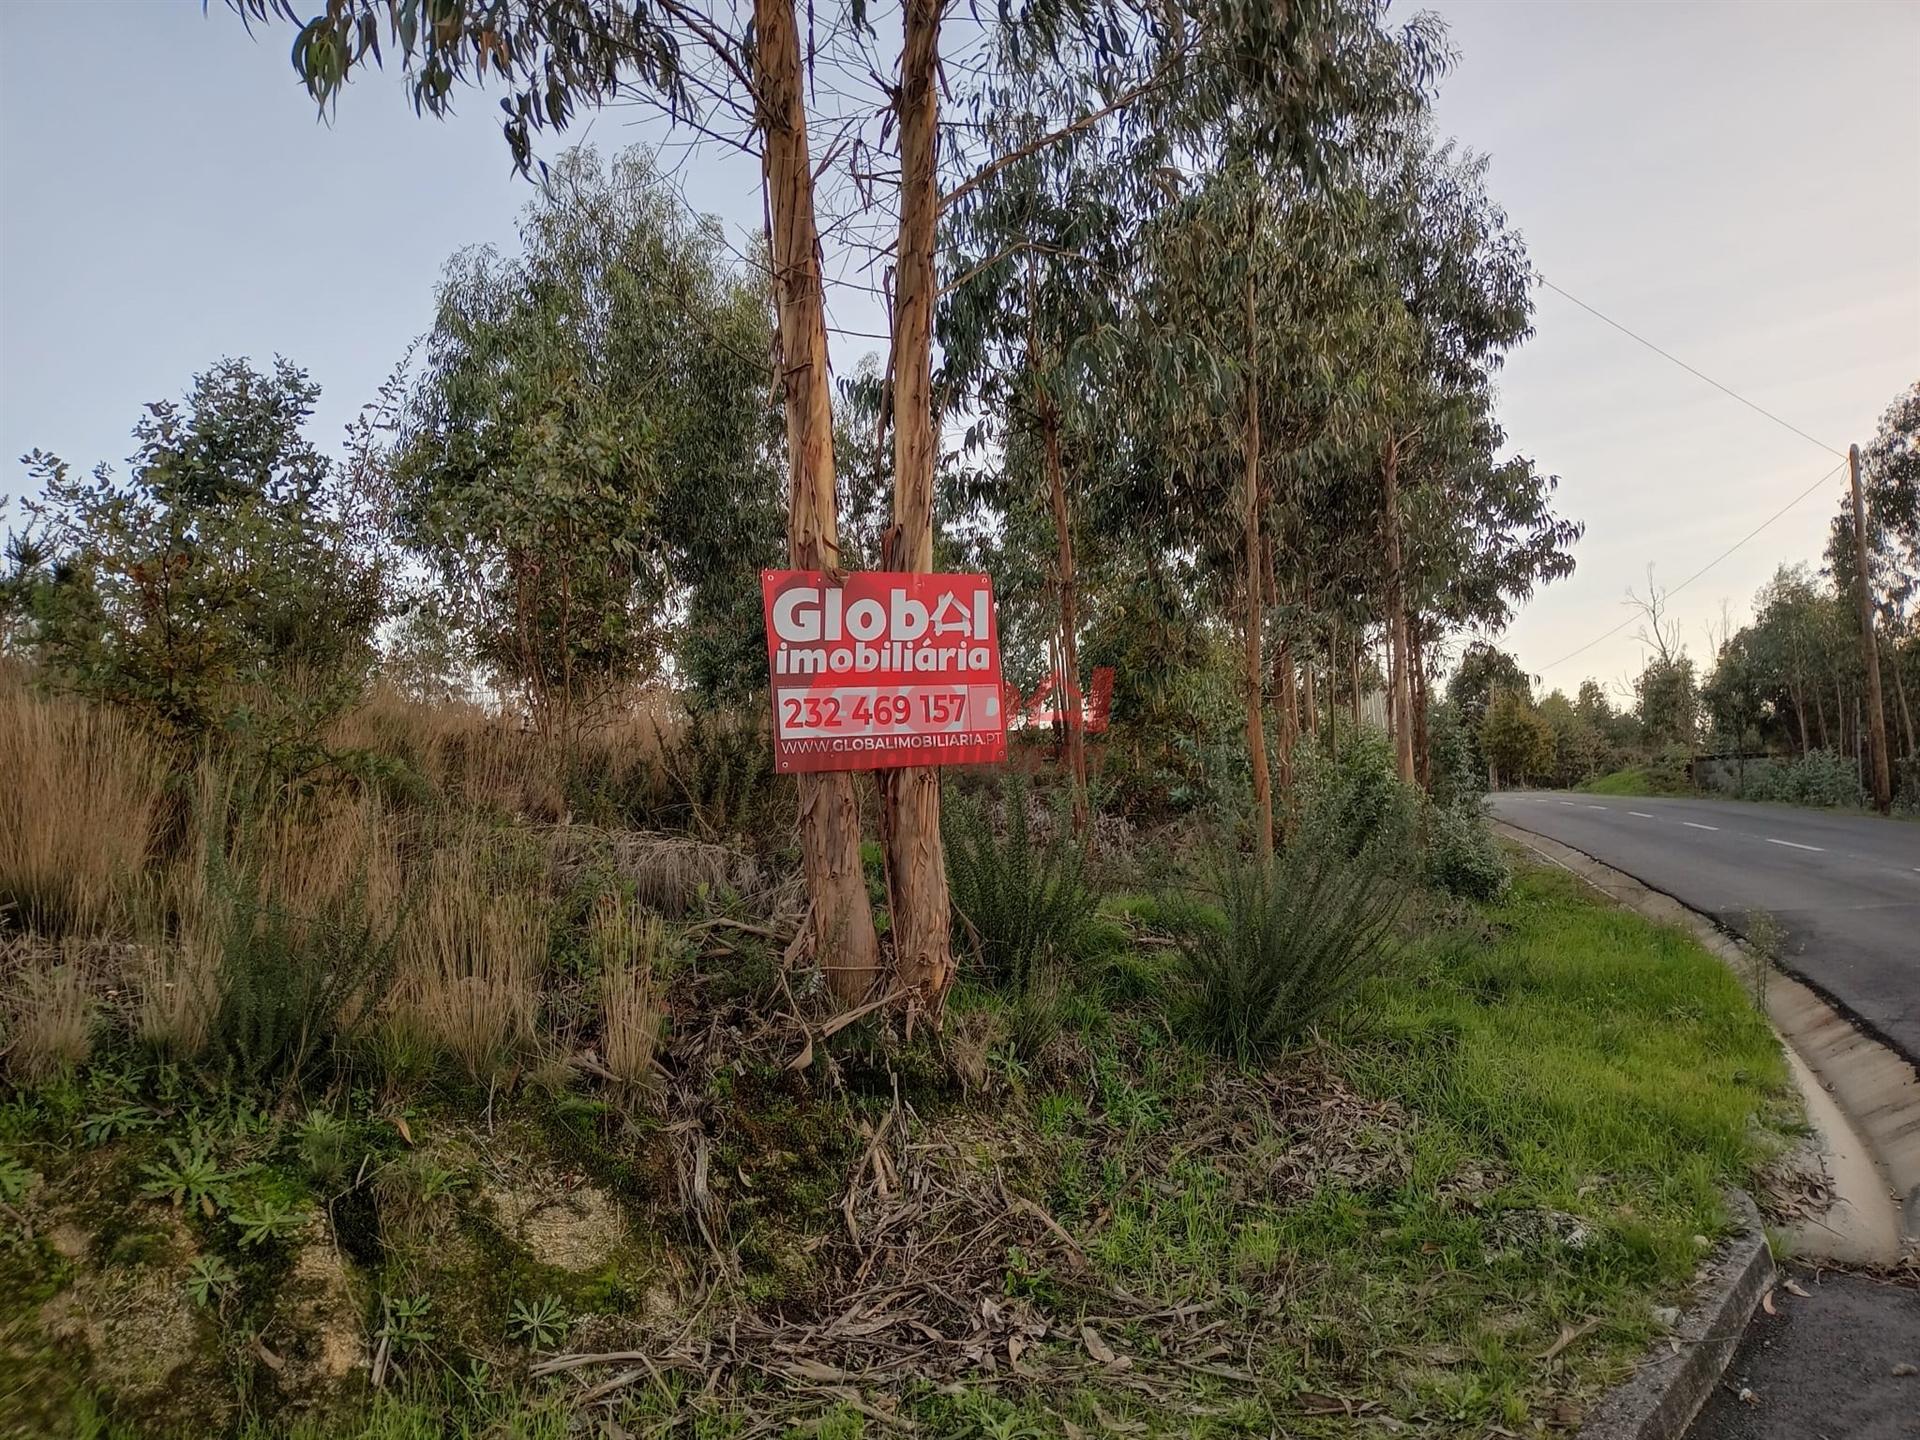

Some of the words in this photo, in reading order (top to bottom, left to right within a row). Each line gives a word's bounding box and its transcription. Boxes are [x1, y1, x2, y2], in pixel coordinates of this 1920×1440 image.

[773, 587, 989, 642] Global
[776, 638, 990, 674] imobiliária
[783, 697, 842, 729] 232
[851, 695, 911, 725] 469
[919, 693, 966, 723] 157
[781, 732, 1002, 755] WWW.GLOBALIMOBILIARIA.PT
